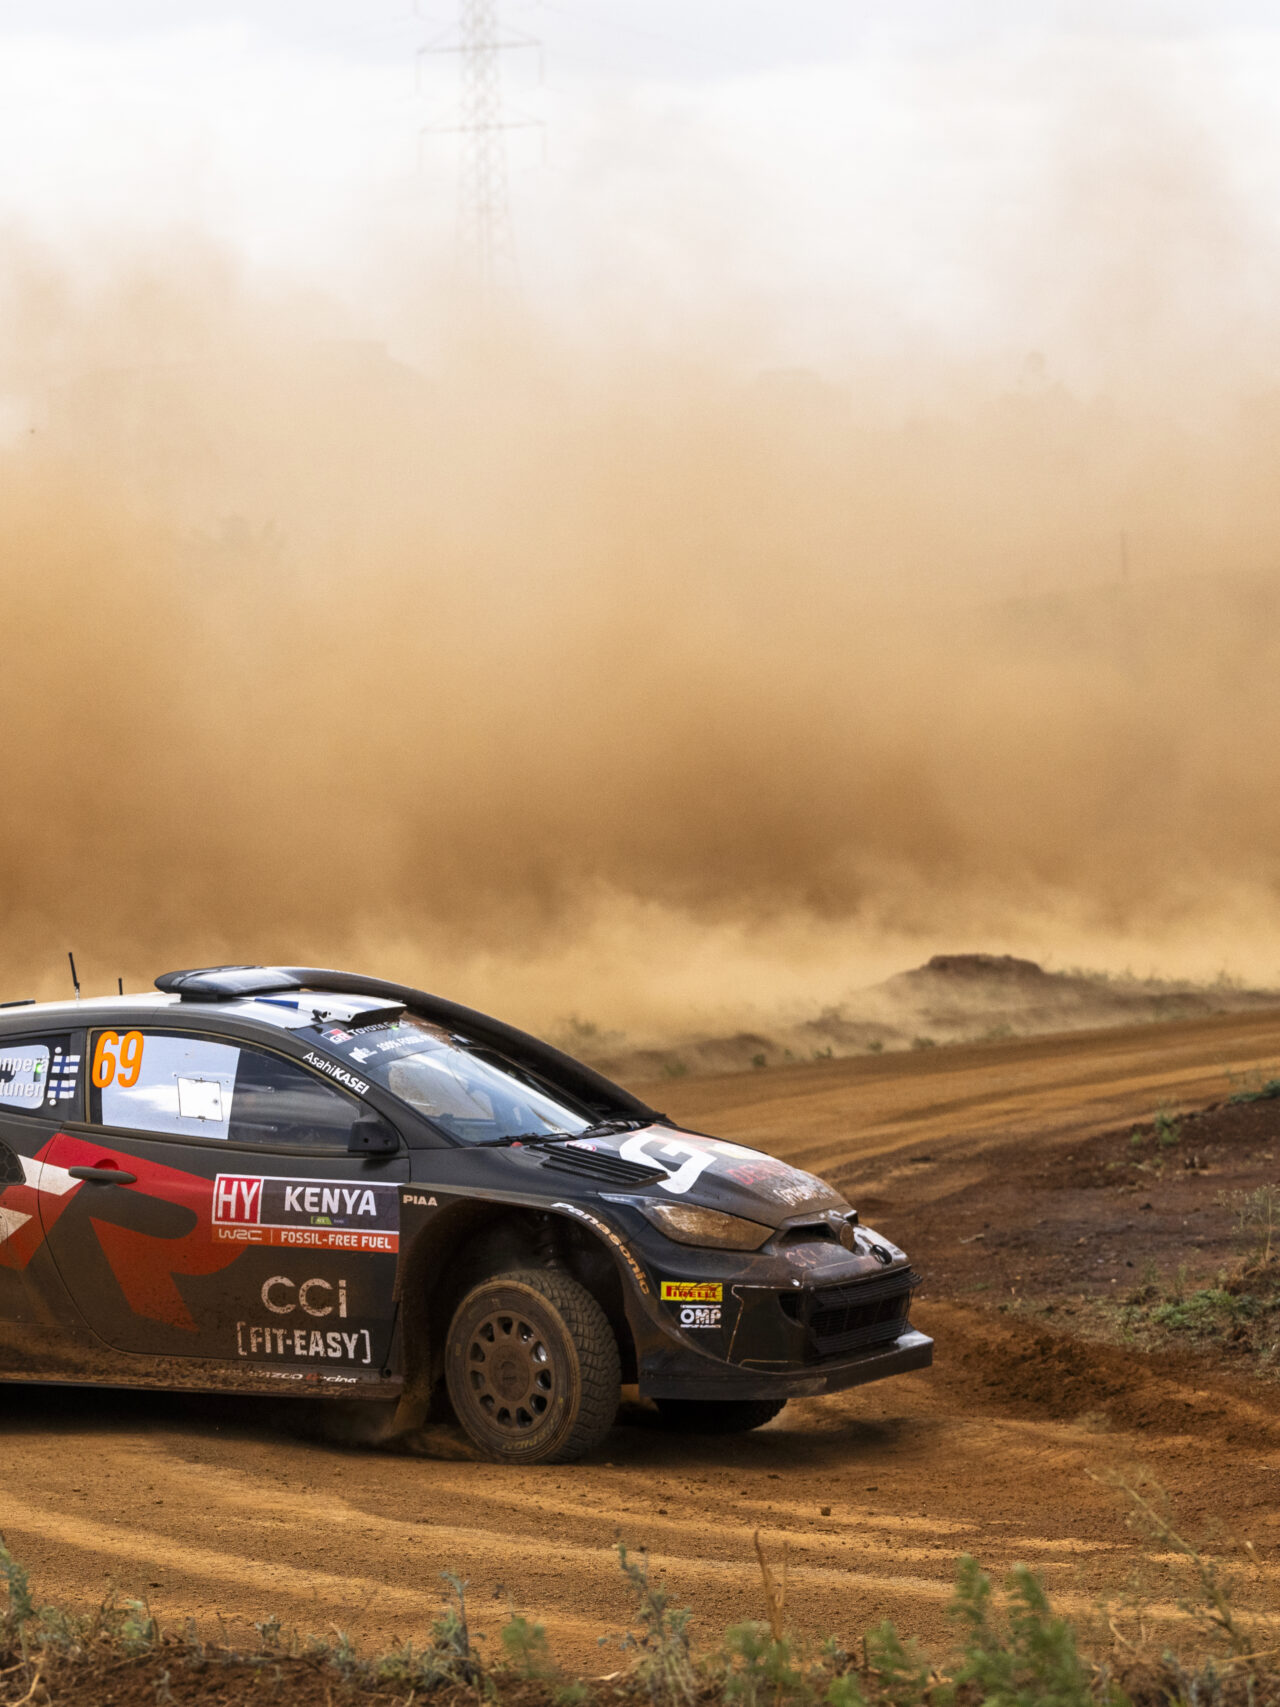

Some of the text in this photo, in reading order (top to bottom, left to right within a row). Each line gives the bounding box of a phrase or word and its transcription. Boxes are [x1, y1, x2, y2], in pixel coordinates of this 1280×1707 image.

[91, 1030, 144, 1088] 69
[302, 1051, 370, 1095] AsahiKASEI
[217, 1180, 260, 1220] HY
[284, 1186, 377, 1216] KENYA
[402, 1194, 438, 1207] PIAA
[218, 1228, 263, 1241] WRC
[281, 1231, 392, 1249] FOSSIL-FREE FUEL
[551, 1202, 650, 1295] Panasonic
[680, 1308, 721, 1324] OMP
